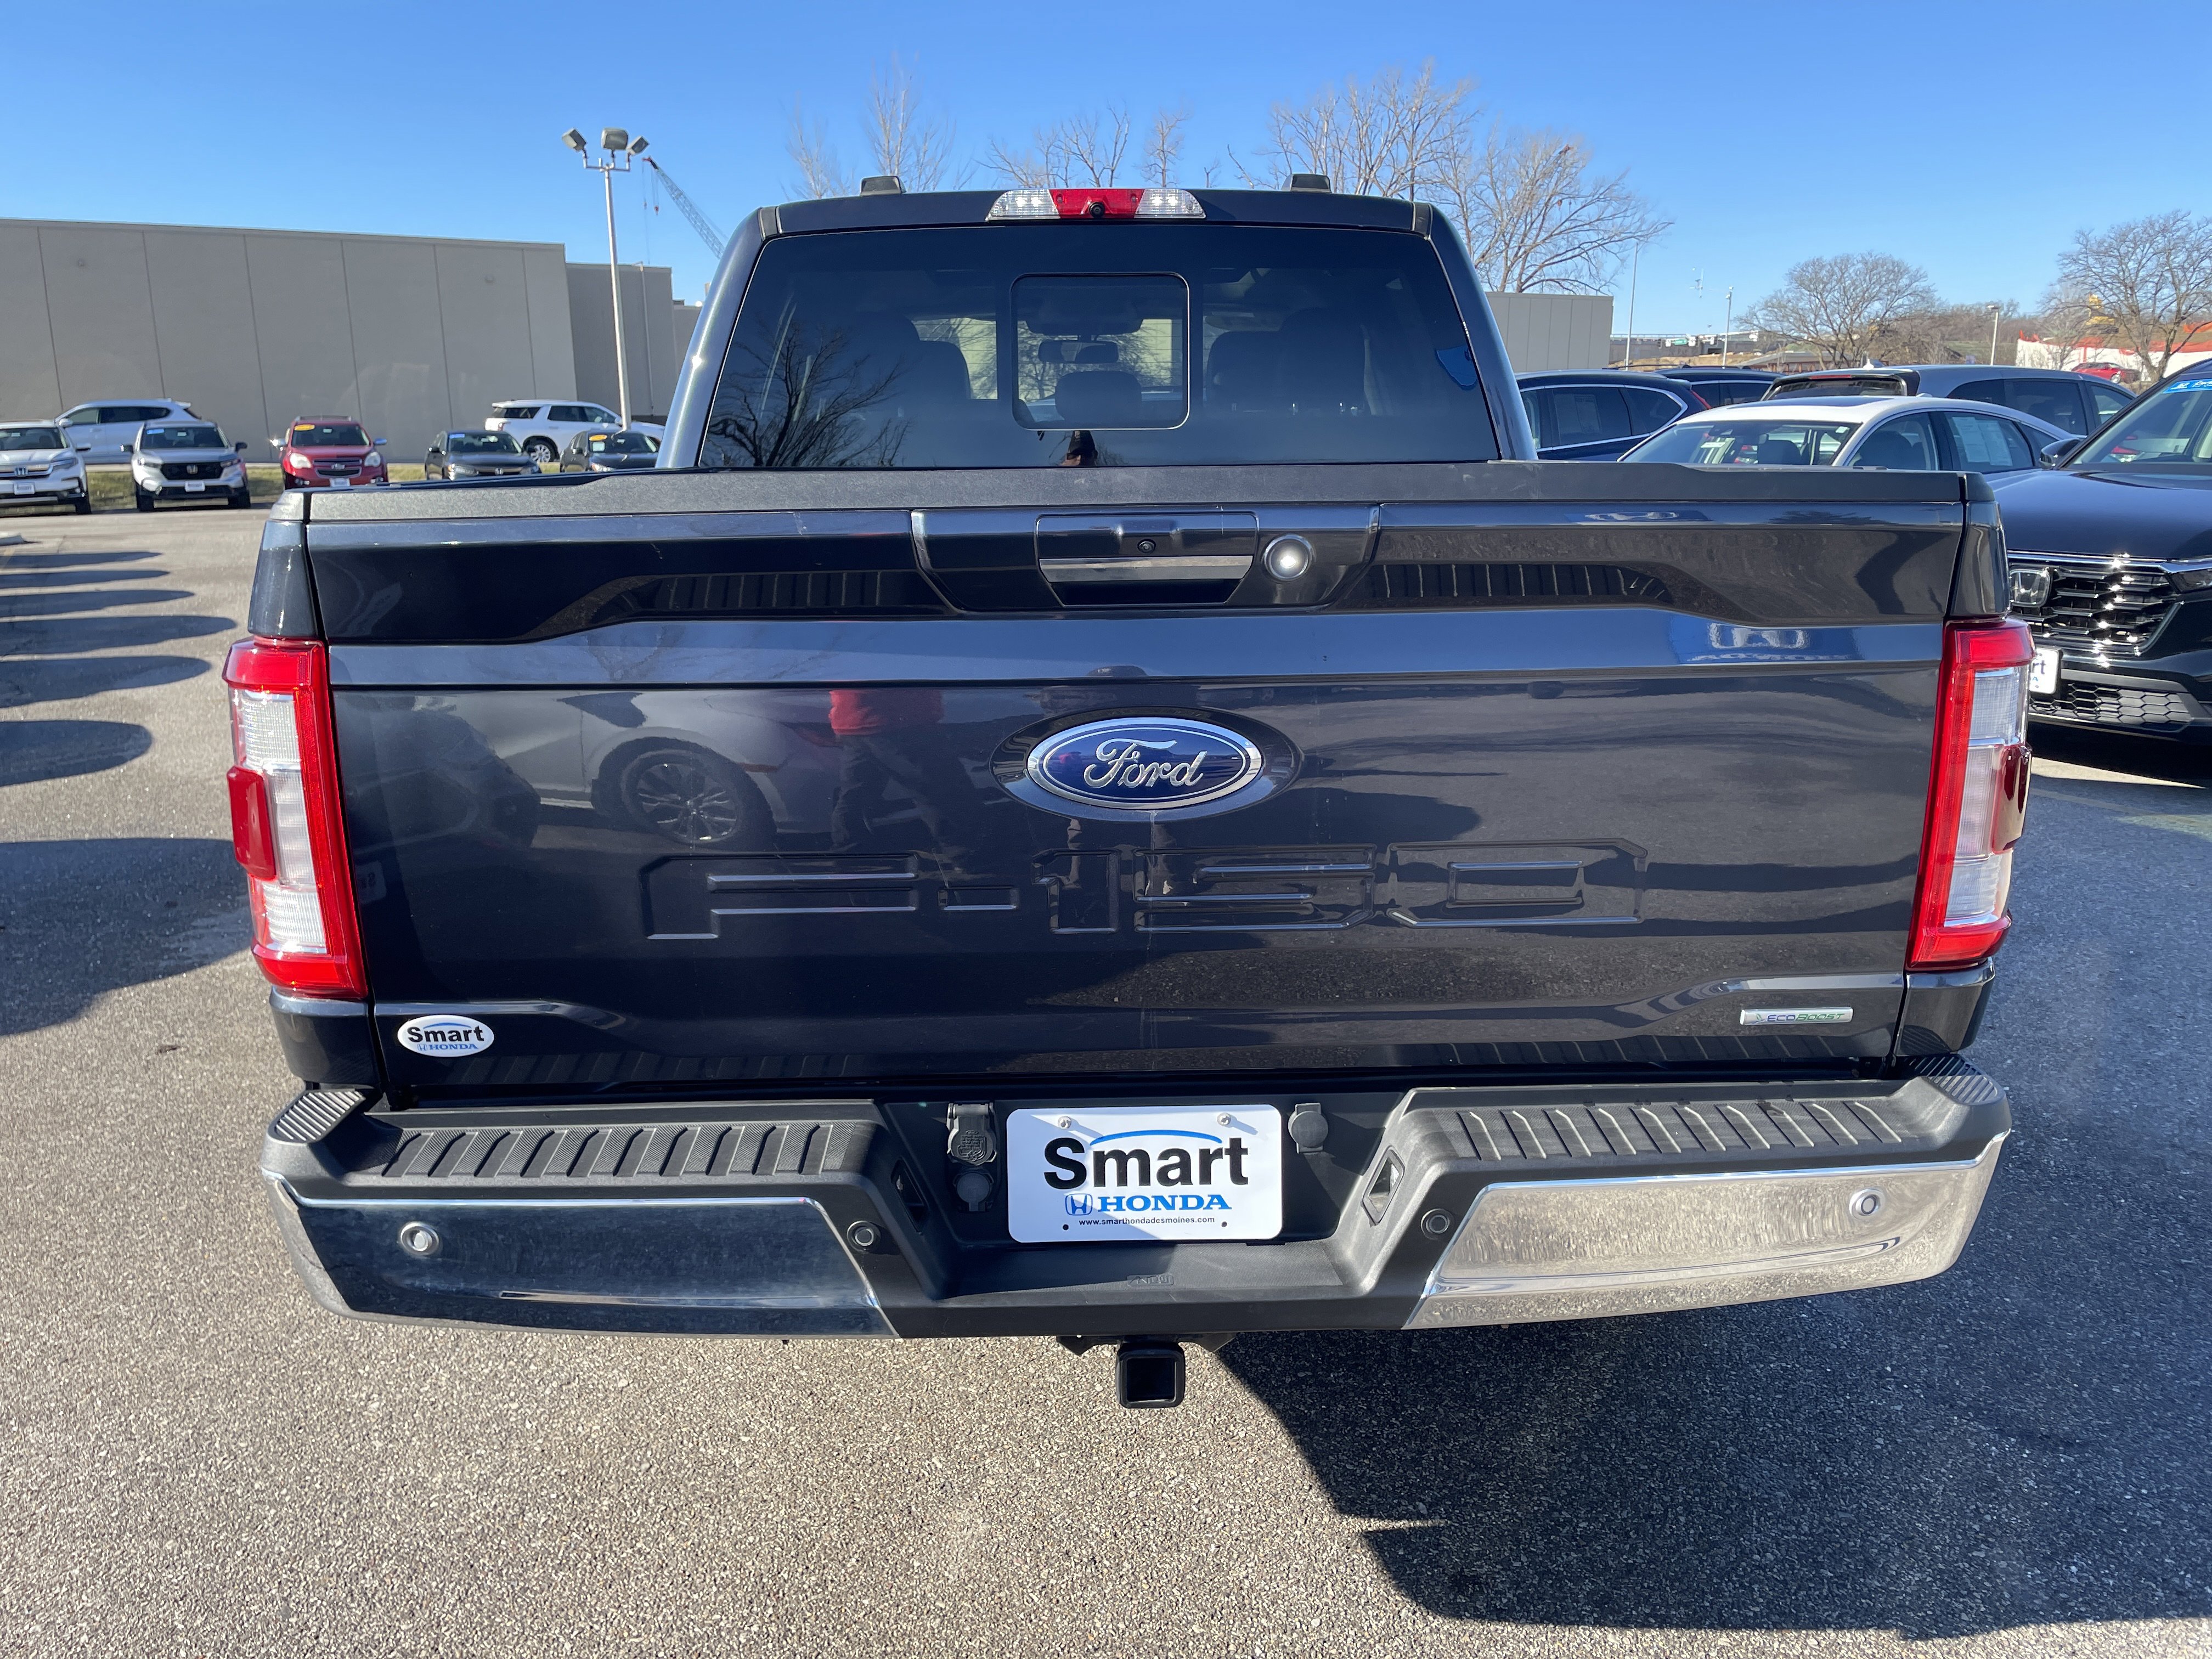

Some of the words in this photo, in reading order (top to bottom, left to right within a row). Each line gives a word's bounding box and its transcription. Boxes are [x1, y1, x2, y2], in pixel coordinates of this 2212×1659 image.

[1084, 737, 1207, 788] Ford
[639, 837, 1647, 940] F-150
[407, 1025, 484, 1042] Smart
[1043, 1137, 1248, 1189] Smart
[1097, 1194, 1232, 1212] HONDA
[1079, 1216, 1215, 1226] www.smarthondadesmoines.com
